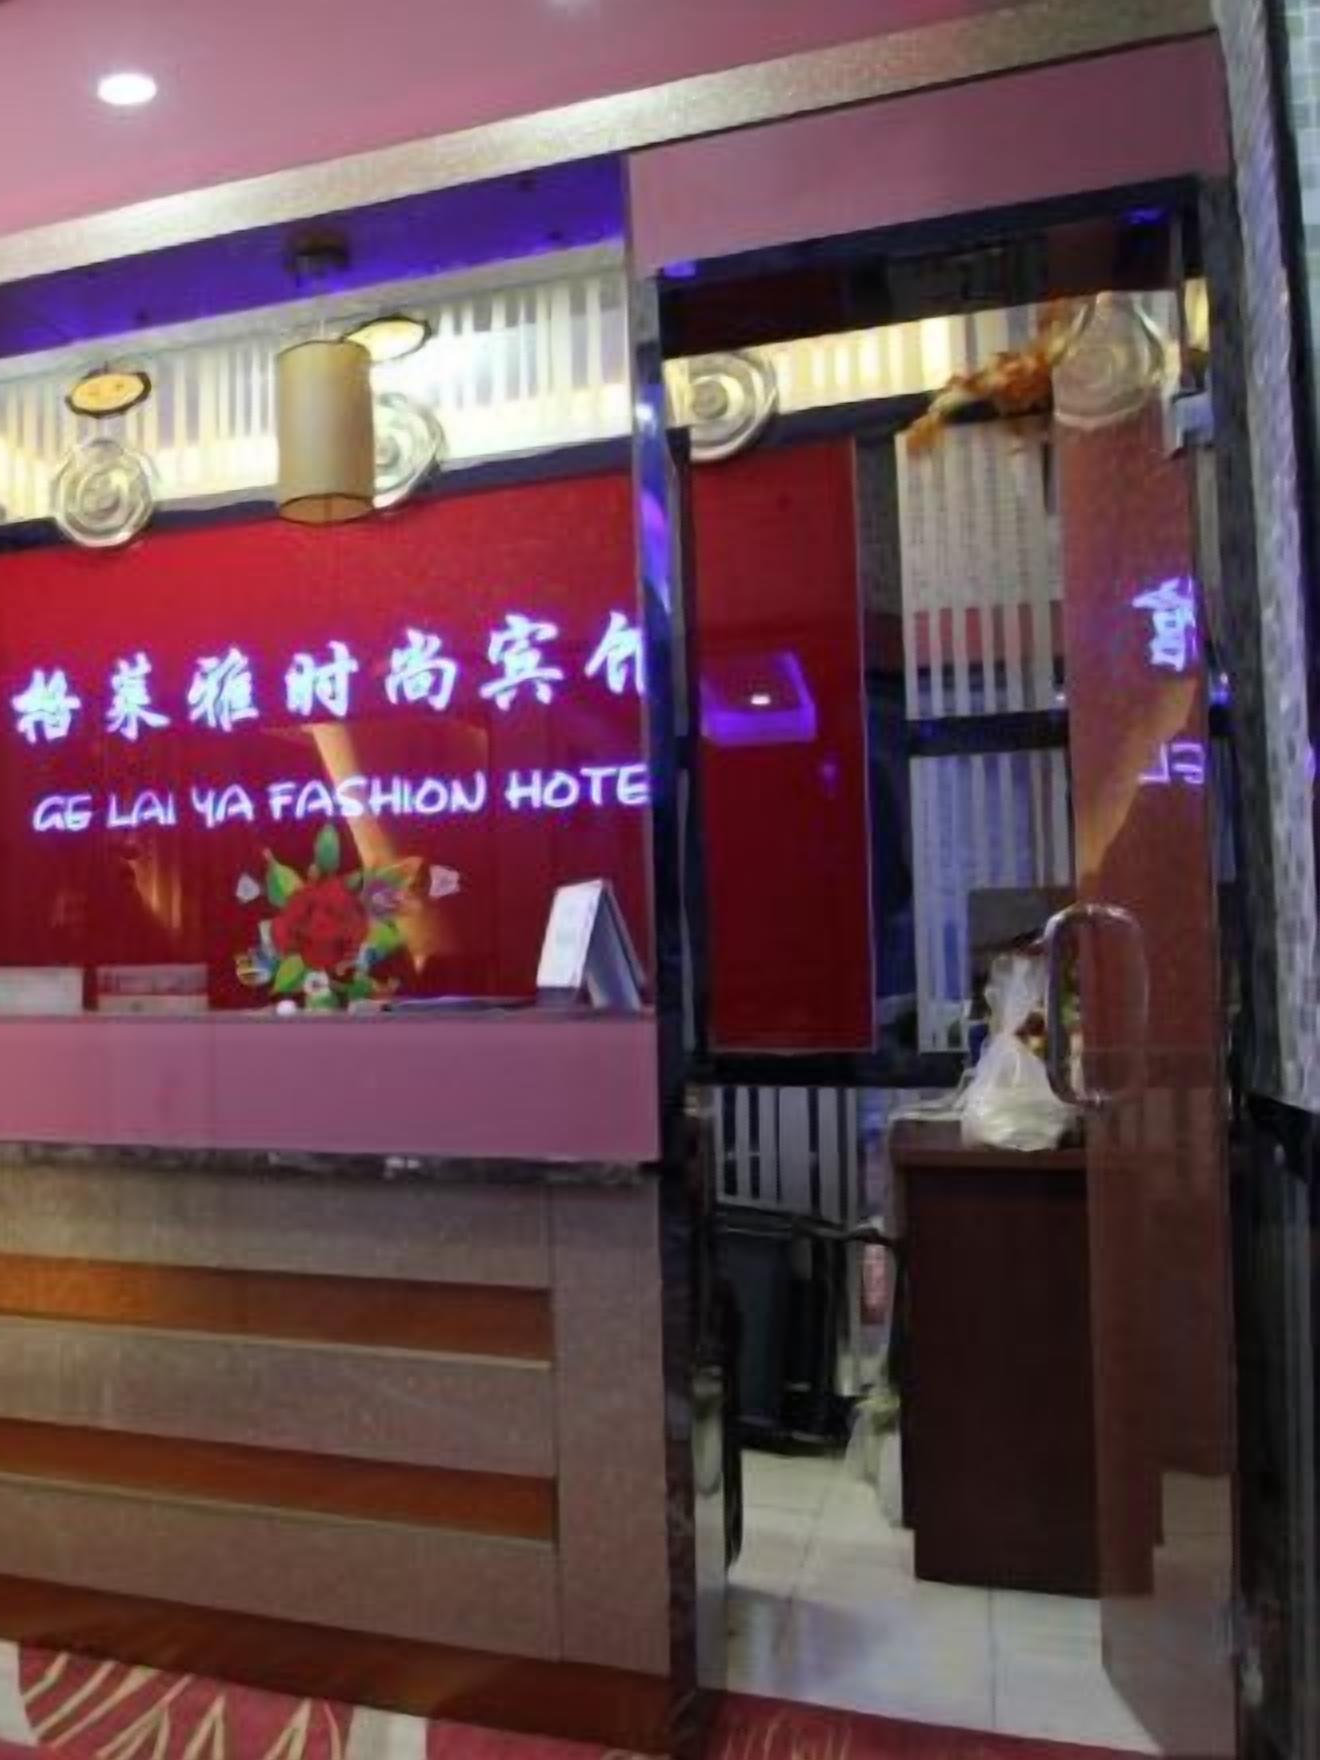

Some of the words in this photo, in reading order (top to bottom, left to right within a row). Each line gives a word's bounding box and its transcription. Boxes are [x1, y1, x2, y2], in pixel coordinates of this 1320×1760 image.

[33, 794, 93, 831] GE
[106, 790, 176, 827] LAI
[191, 784, 254, 828] YA
[268, 771, 487, 820] FASHION
[505, 764, 651, 809] HOTE
